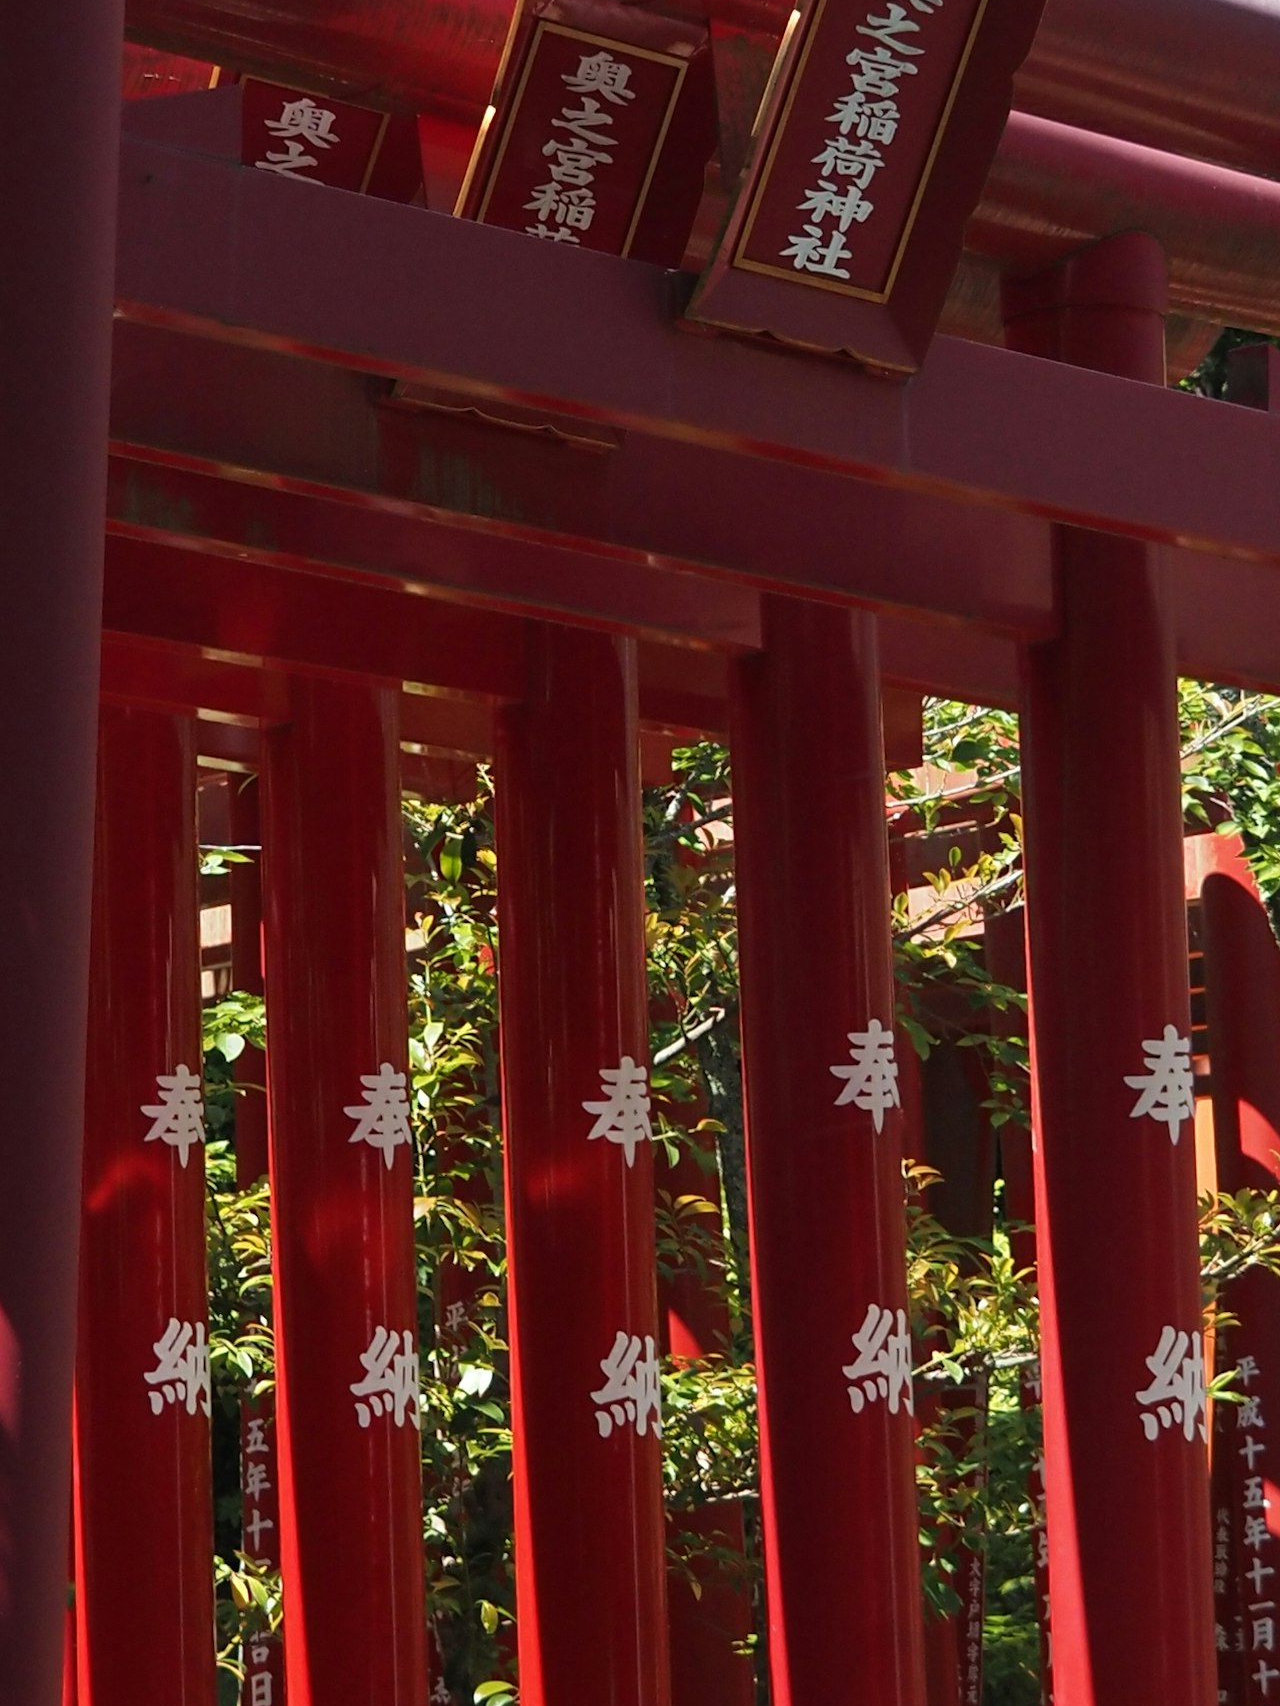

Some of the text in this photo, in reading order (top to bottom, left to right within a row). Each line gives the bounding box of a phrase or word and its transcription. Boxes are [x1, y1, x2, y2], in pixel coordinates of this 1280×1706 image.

[140, 1063, 212, 1418] 奉納
[343, 1062, 421, 1431] 奉納
[583, 1055, 664, 1439] 奉納
[829, 1019, 914, 1418] 奉納
[1123, 1024, 1208, 1444] 奉納
